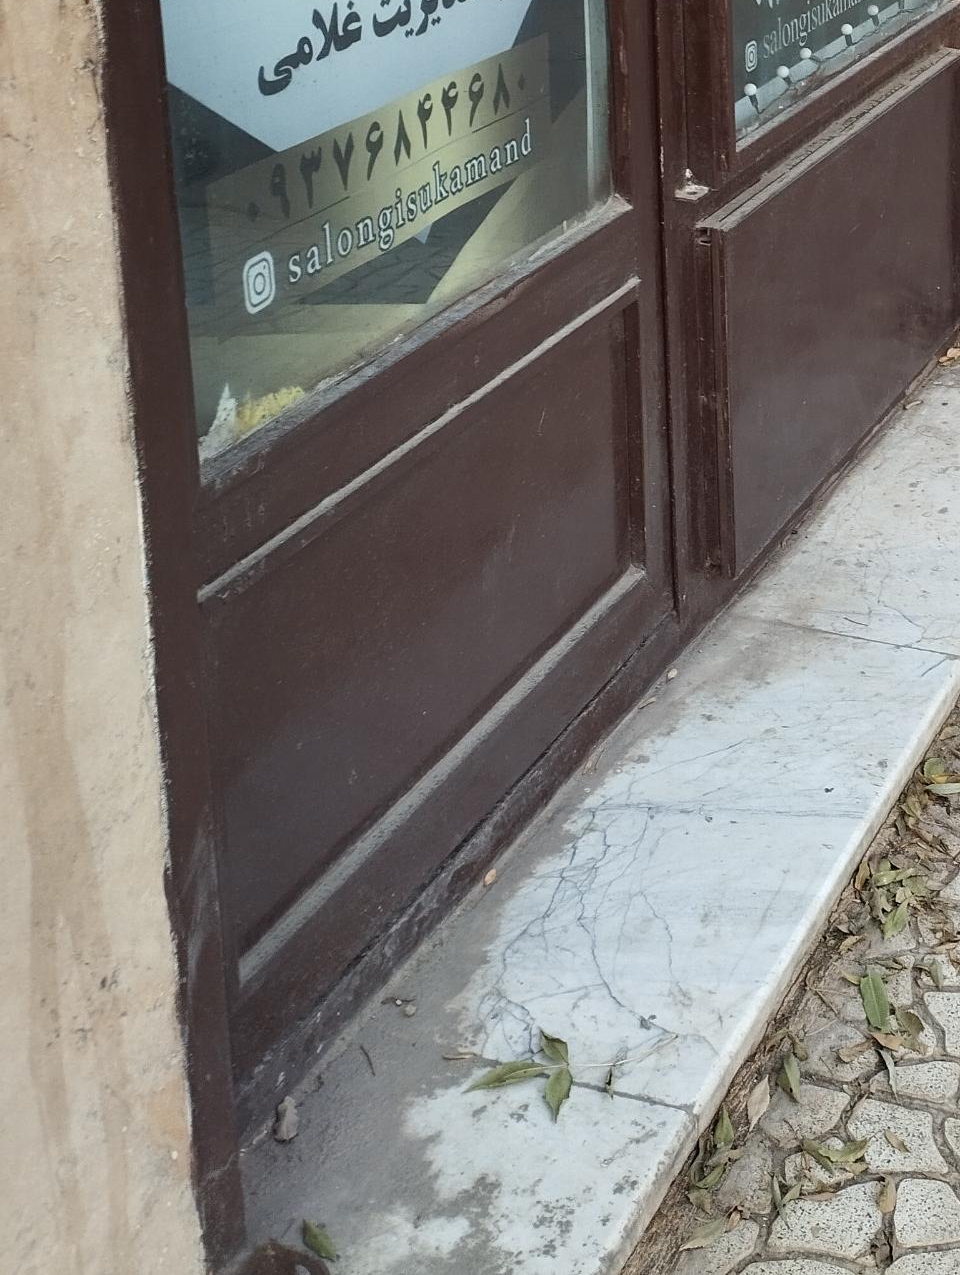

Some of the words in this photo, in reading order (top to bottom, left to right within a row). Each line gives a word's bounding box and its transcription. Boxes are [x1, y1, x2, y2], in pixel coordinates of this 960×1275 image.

[258, 1, 362, 96] غلامی
[248, 63, 525, 222] ۰۹۳۷۶۸۴۴۶۸۰
[288, 118, 533, 284] salongisukamand
